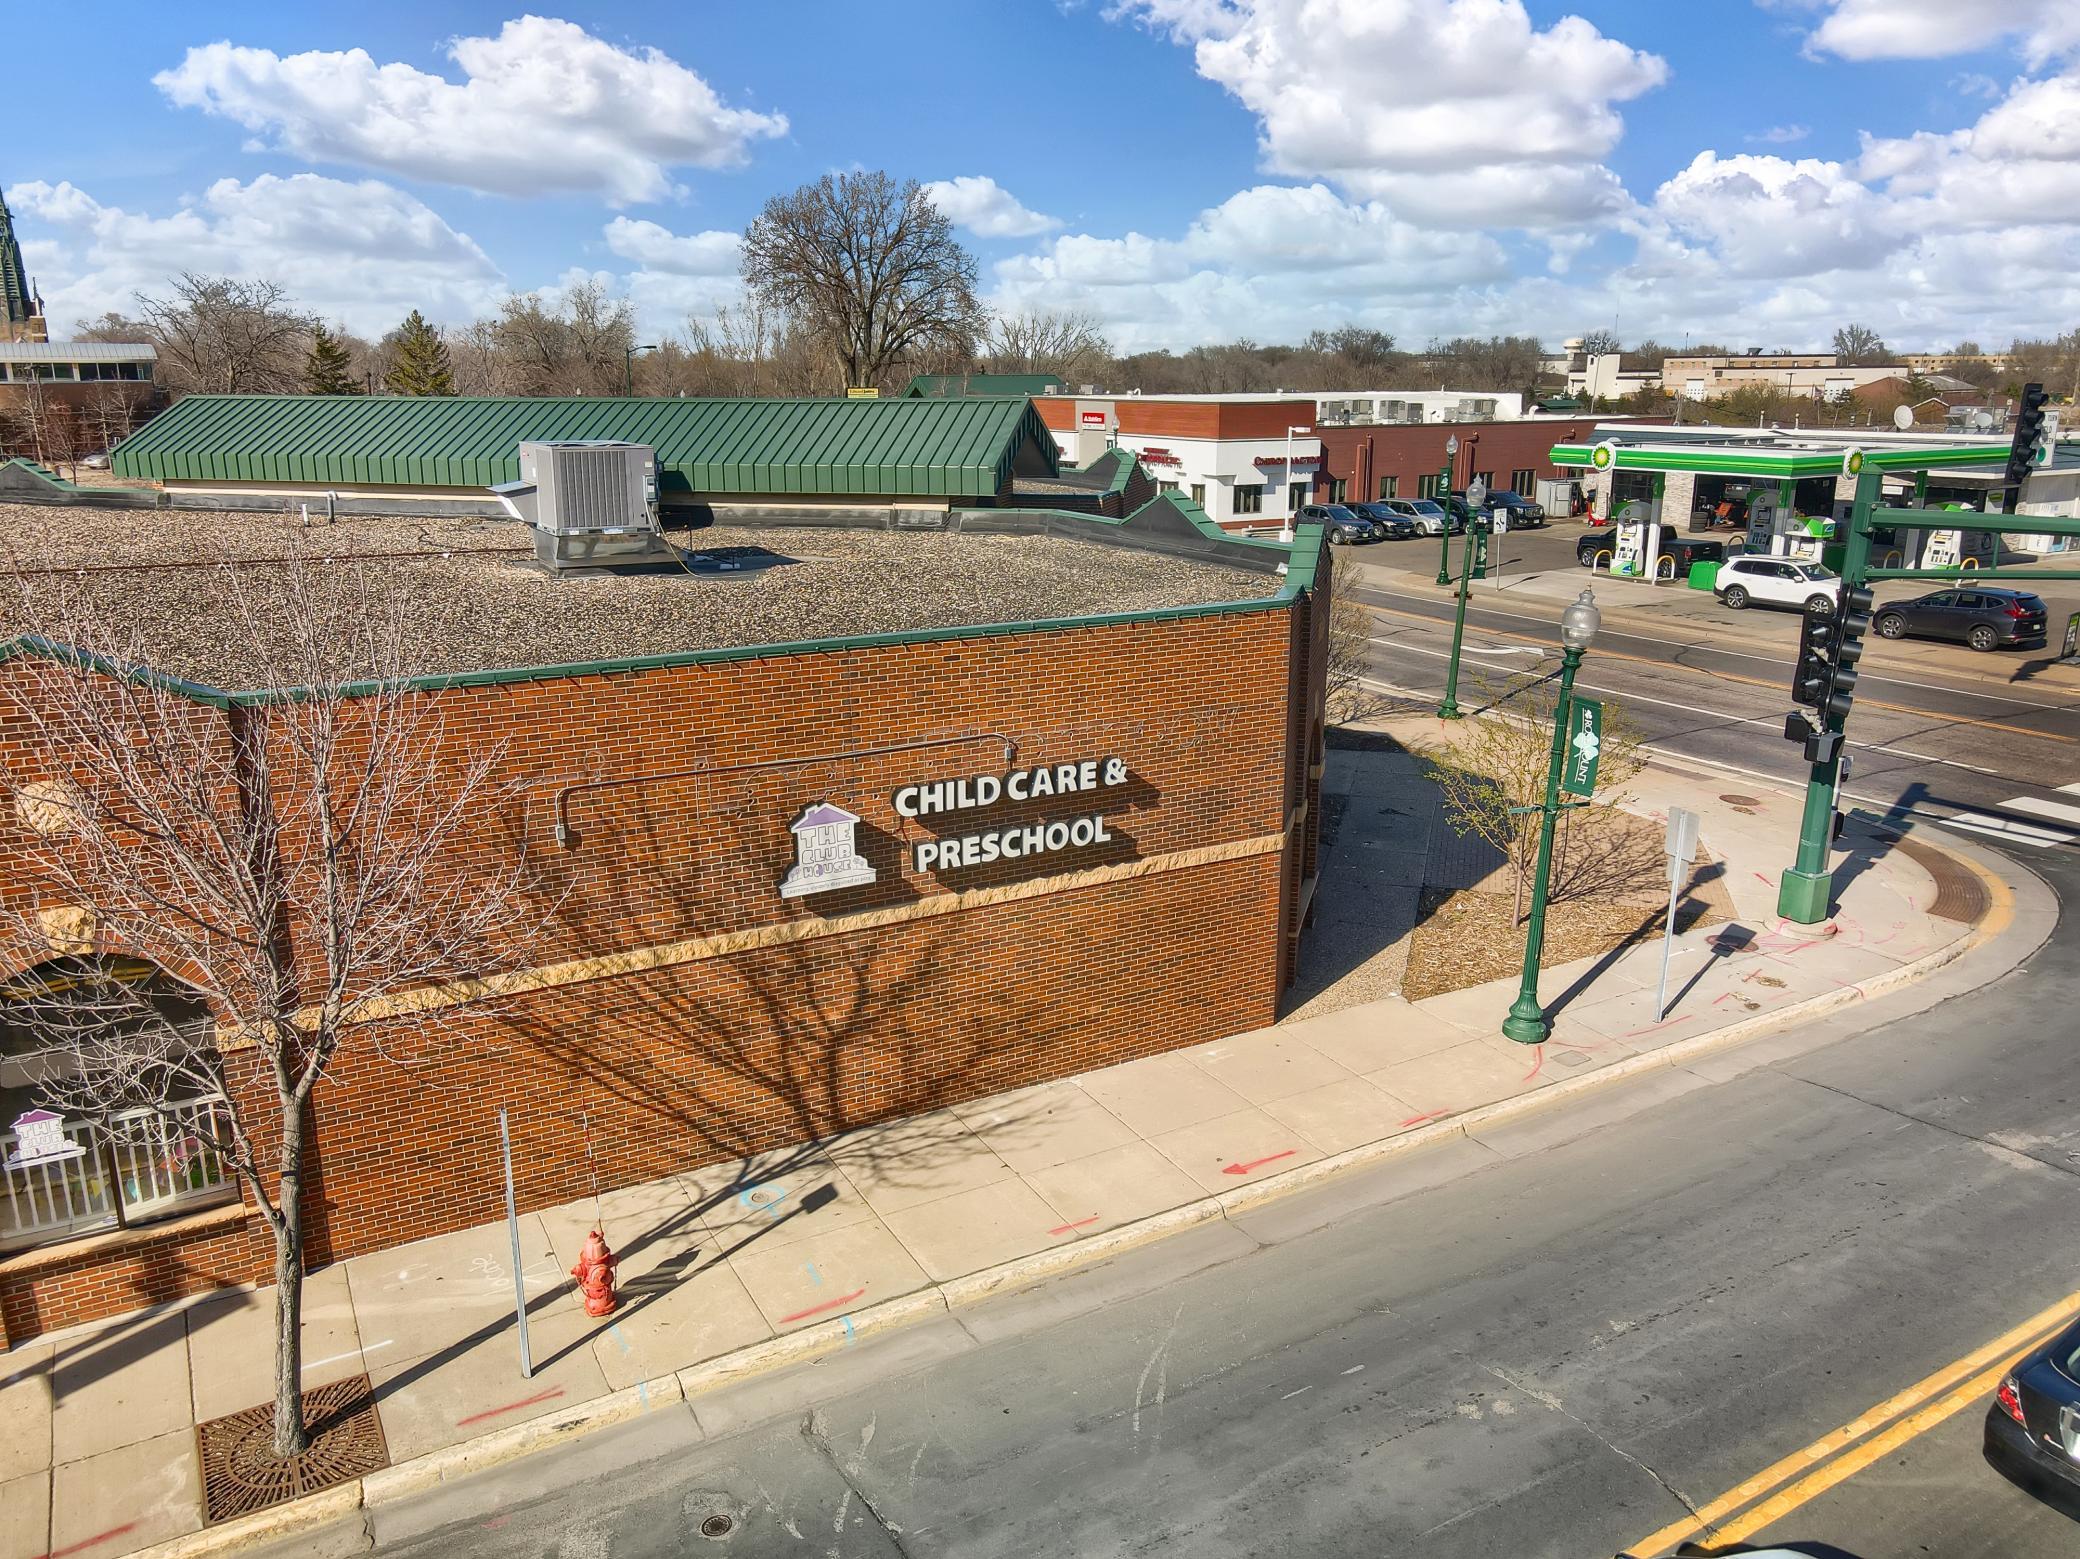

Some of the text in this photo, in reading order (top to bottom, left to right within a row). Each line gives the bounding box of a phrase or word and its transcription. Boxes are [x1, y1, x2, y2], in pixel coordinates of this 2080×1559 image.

[1577, 719, 1592, 785] ROOUNT
[895, 757, 1128, 818] CHILD CARE &
[800, 822, 851, 848] THE
[917, 815, 1112, 873] PRESCHOOL
[802, 843, 851, 864] CLUB
[803, 860, 851, 878] HOUSE
[17, 1118, 62, 1138] THE
